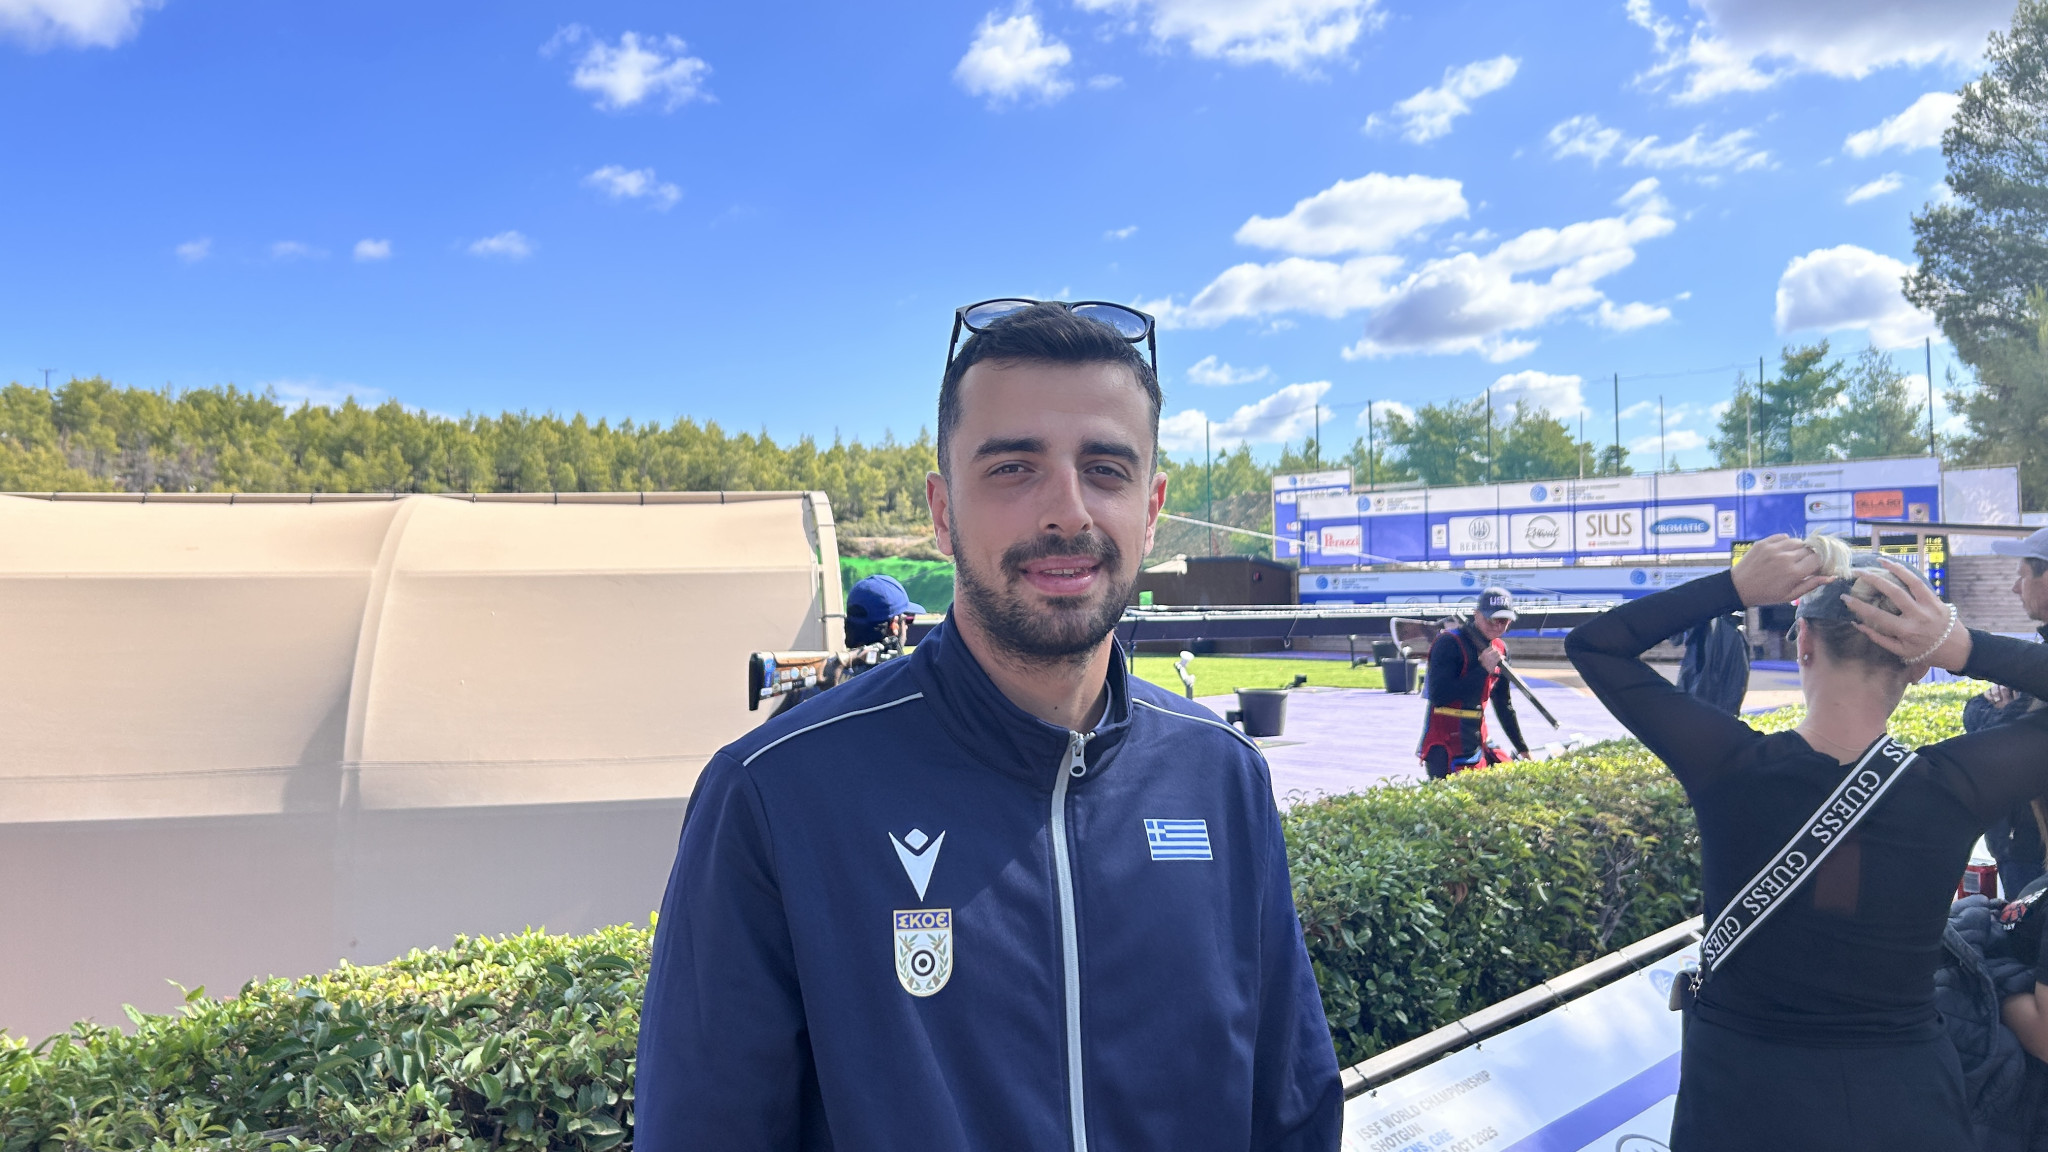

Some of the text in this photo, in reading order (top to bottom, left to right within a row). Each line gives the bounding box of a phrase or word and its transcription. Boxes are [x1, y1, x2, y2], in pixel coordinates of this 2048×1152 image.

[1585, 512, 1633, 537] SIUS
[1324, 533, 1360, 548] Perazzi
[1460, 541, 1500, 552] BERETTA
[1489, 596, 1510, 606] USA
[1811, 769, 1881, 844] GUESS
[1742, 850, 1808, 916] GUESS
[1704, 916, 1741, 966] GUES
[1356, 1069, 1492, 1142] ISSF WORLD CHAMPIONSHIP
[1370, 1121, 1425, 1152] SHOTGUN
[1428, 1128, 1455, 1146] GRE
[1472, 1125, 1499, 1146] 2025
